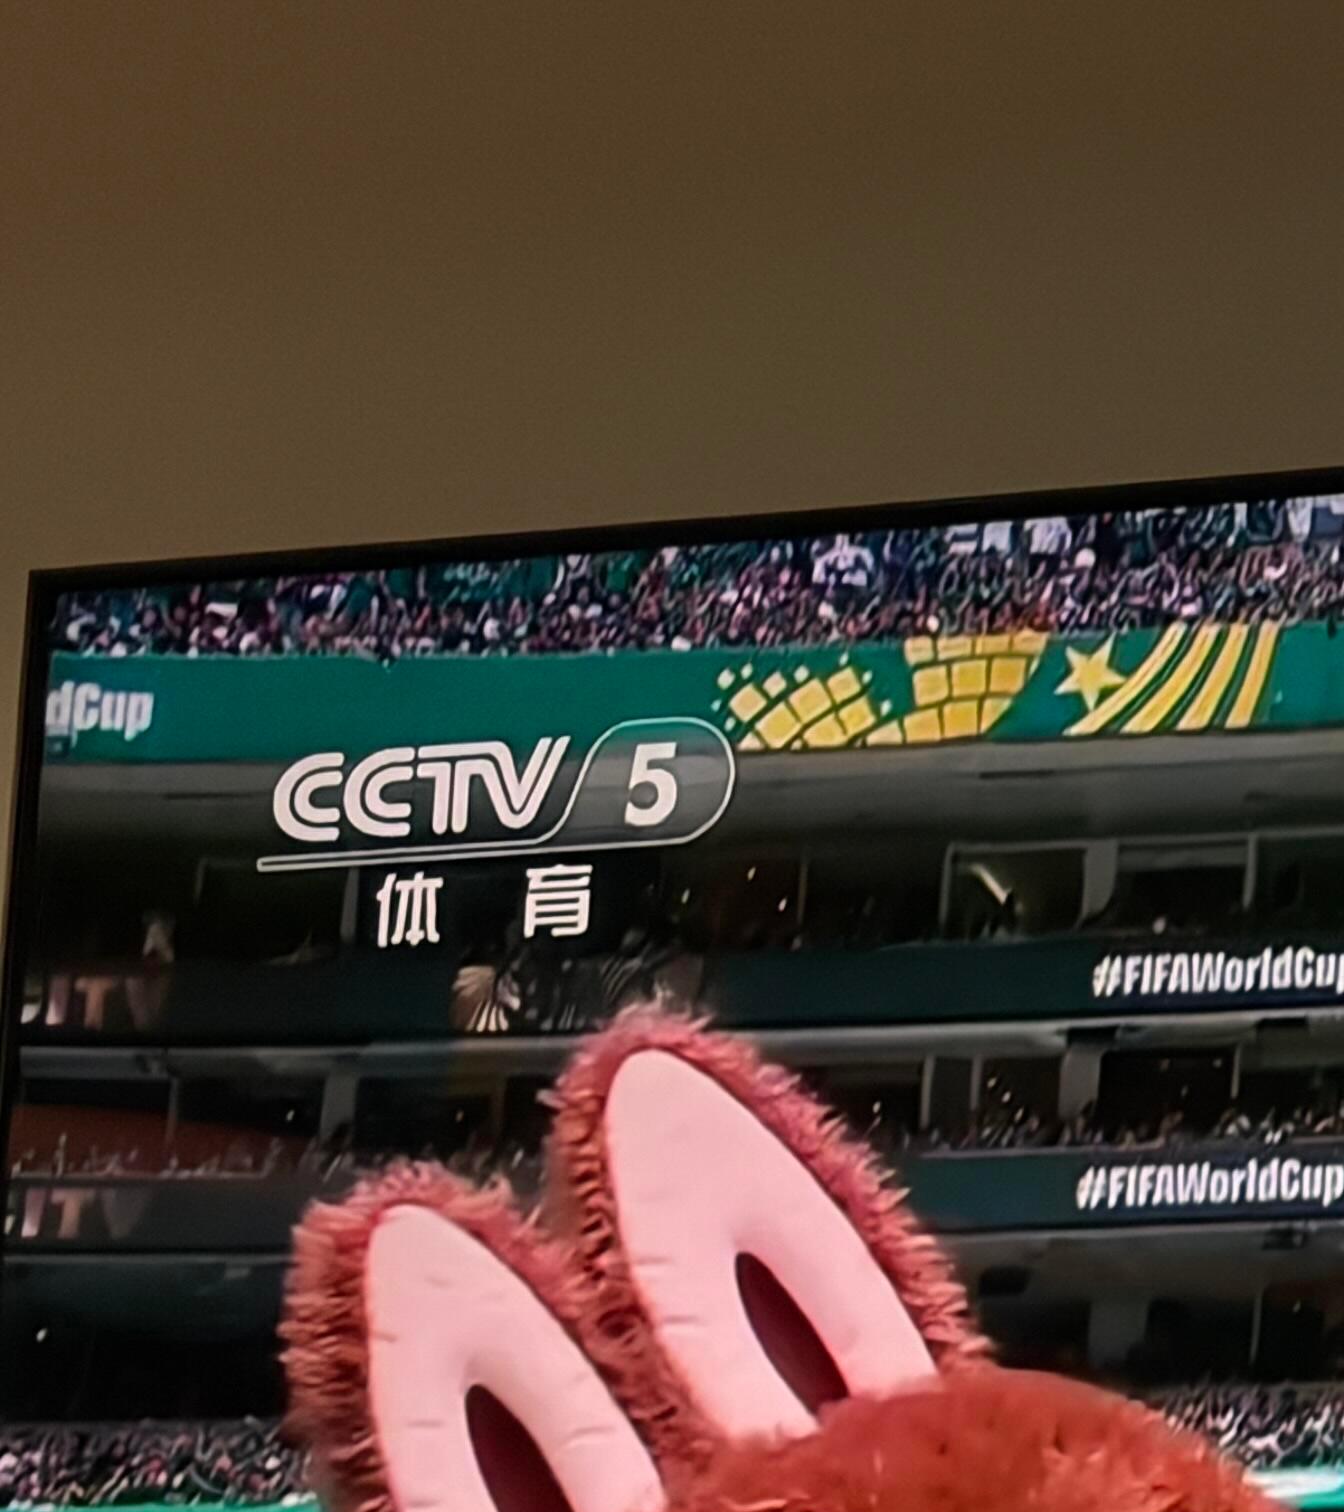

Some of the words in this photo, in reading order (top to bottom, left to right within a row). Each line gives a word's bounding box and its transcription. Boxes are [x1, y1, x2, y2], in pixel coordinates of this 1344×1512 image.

[272, 735, 571, 842] CCTV
[624, 742, 678, 826] 5
[376, 864, 594, 948] 体育
[1076, 1158, 1344, 1209] #FIFAWorldCup
